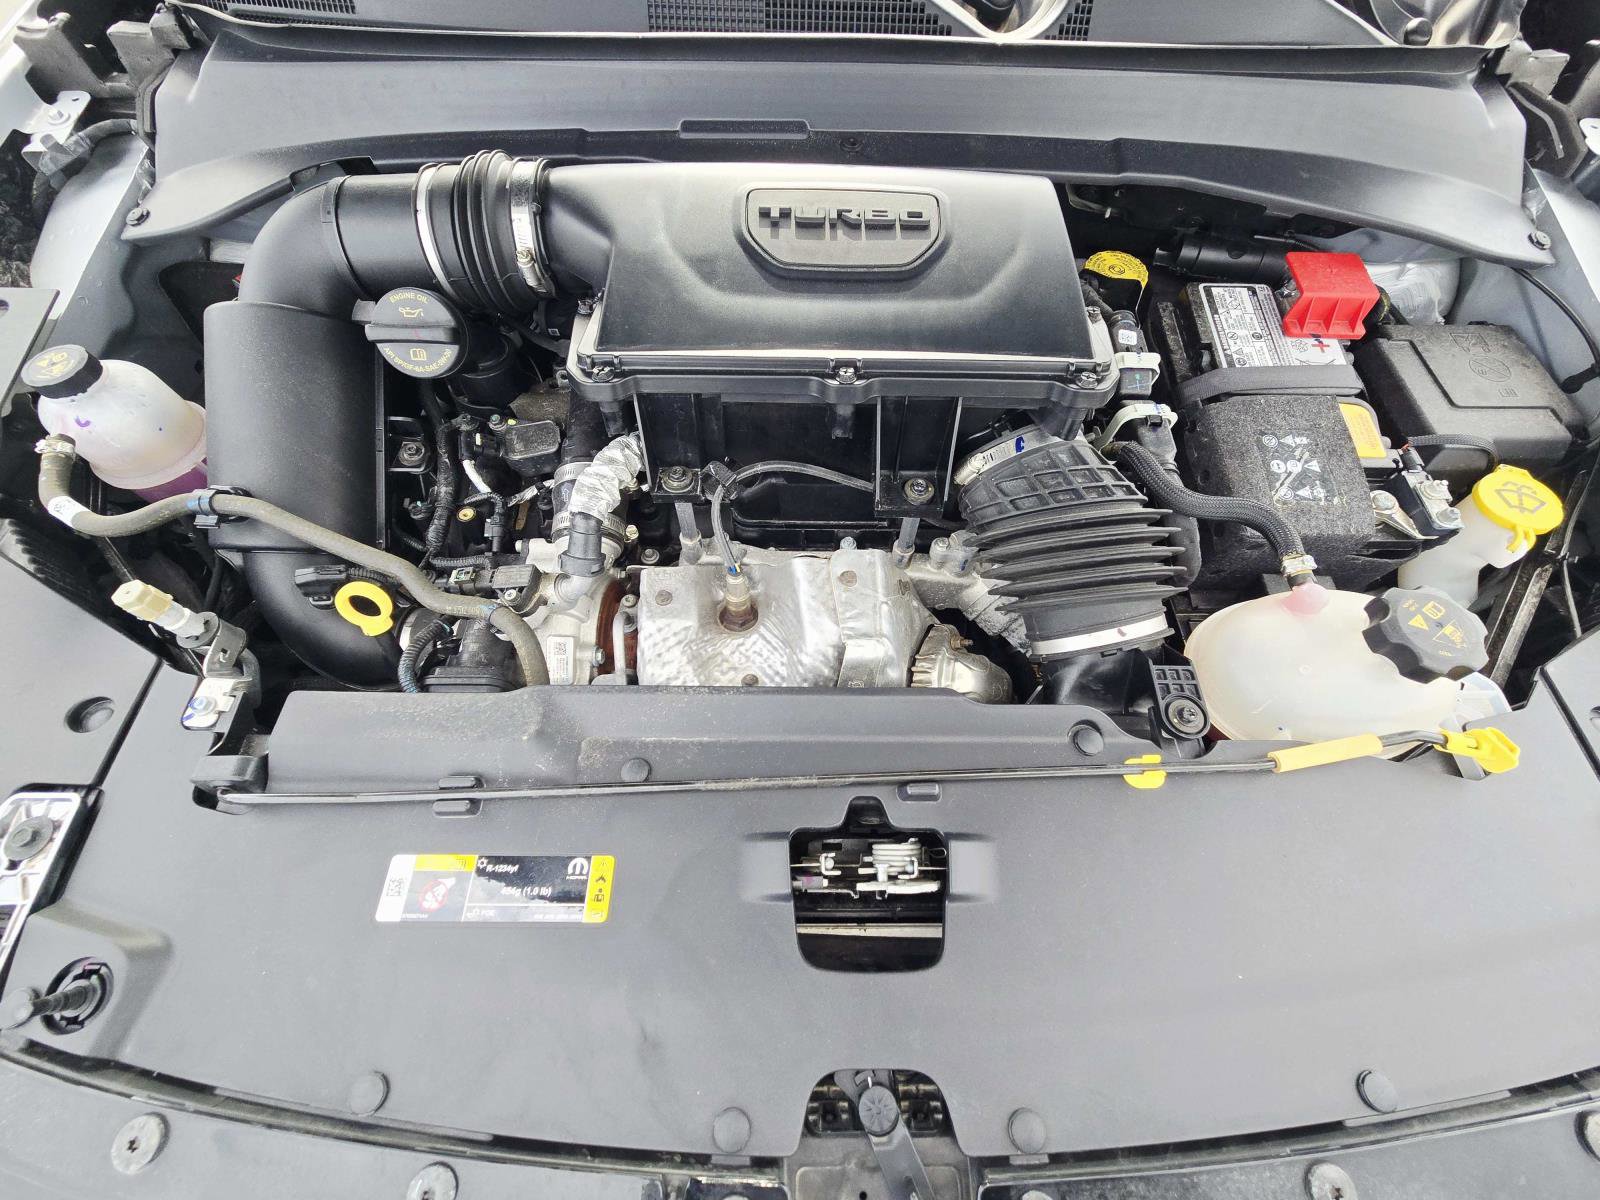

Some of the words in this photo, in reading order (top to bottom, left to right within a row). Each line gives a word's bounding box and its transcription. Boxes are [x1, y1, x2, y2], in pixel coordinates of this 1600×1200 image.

[758, 206, 931, 232] TURBO
[389, 292, 415, 303] ENGINE
[416, 294, 429, 304] OIL
[384, 347, 394, 359] API
[486, 864, 519, 874] R-1234yf
[522, 886, 539, 897] (1.0
[539, 886, 552, 897] lb)
